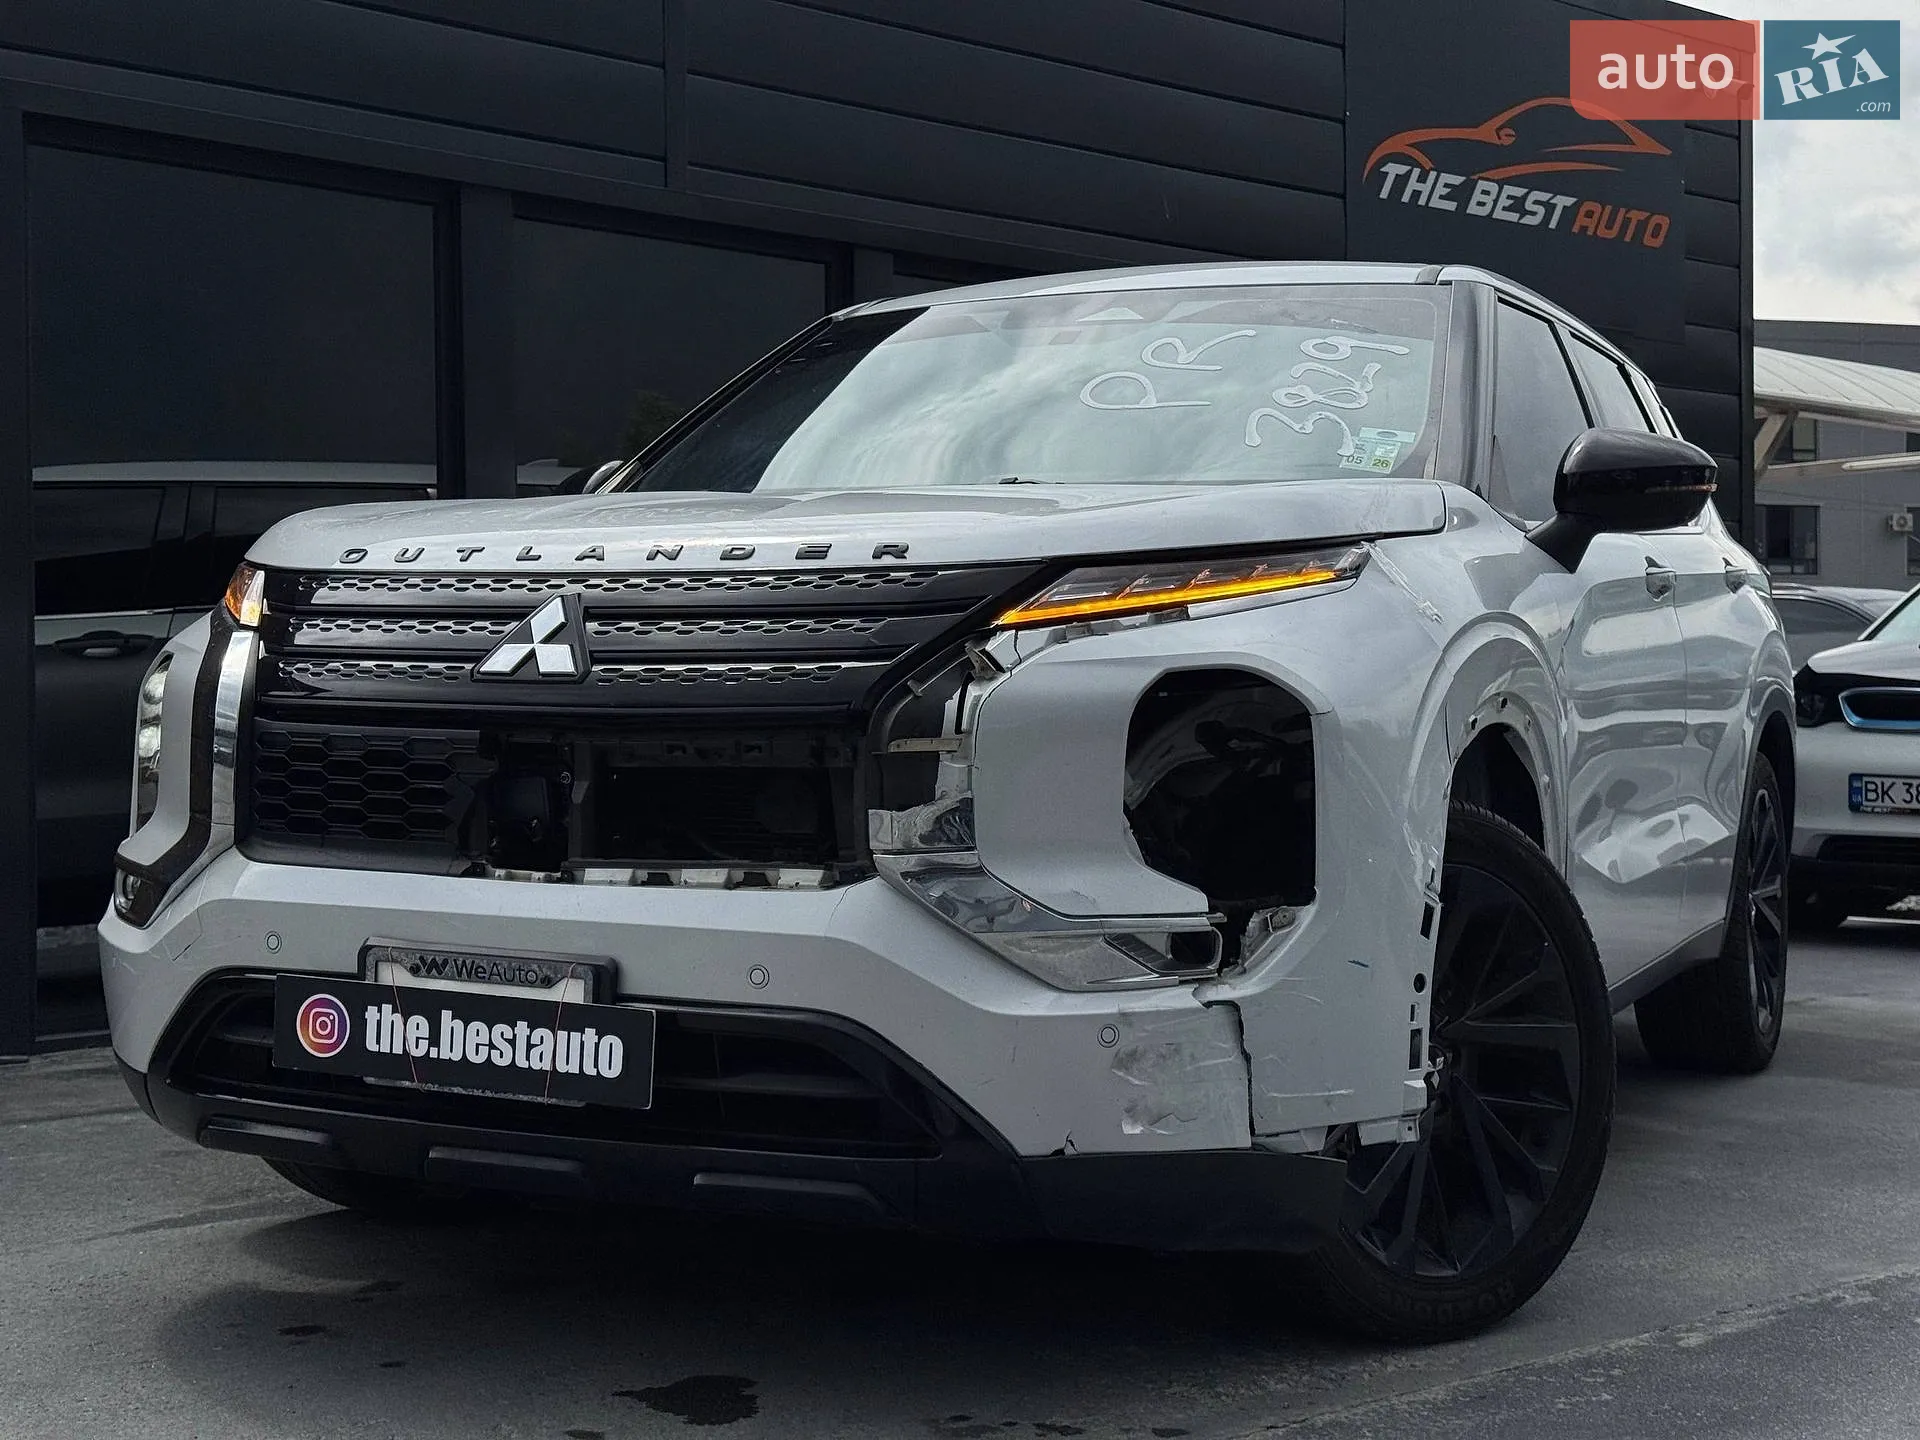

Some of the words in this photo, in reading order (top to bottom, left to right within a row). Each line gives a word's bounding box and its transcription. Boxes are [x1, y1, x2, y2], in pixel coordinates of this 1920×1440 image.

[1379, 162, 1466, 212] THE
[1466, 179, 1578, 230] BEST
[1571, 201, 1671, 249] AUTO
[1372, 458, 1391, 468] 26
[338, 542, 911, 565] OUTLANDER
[453, 958, 539, 985] WeAuto
[364, 1003, 624, 1079] the.bestauto
